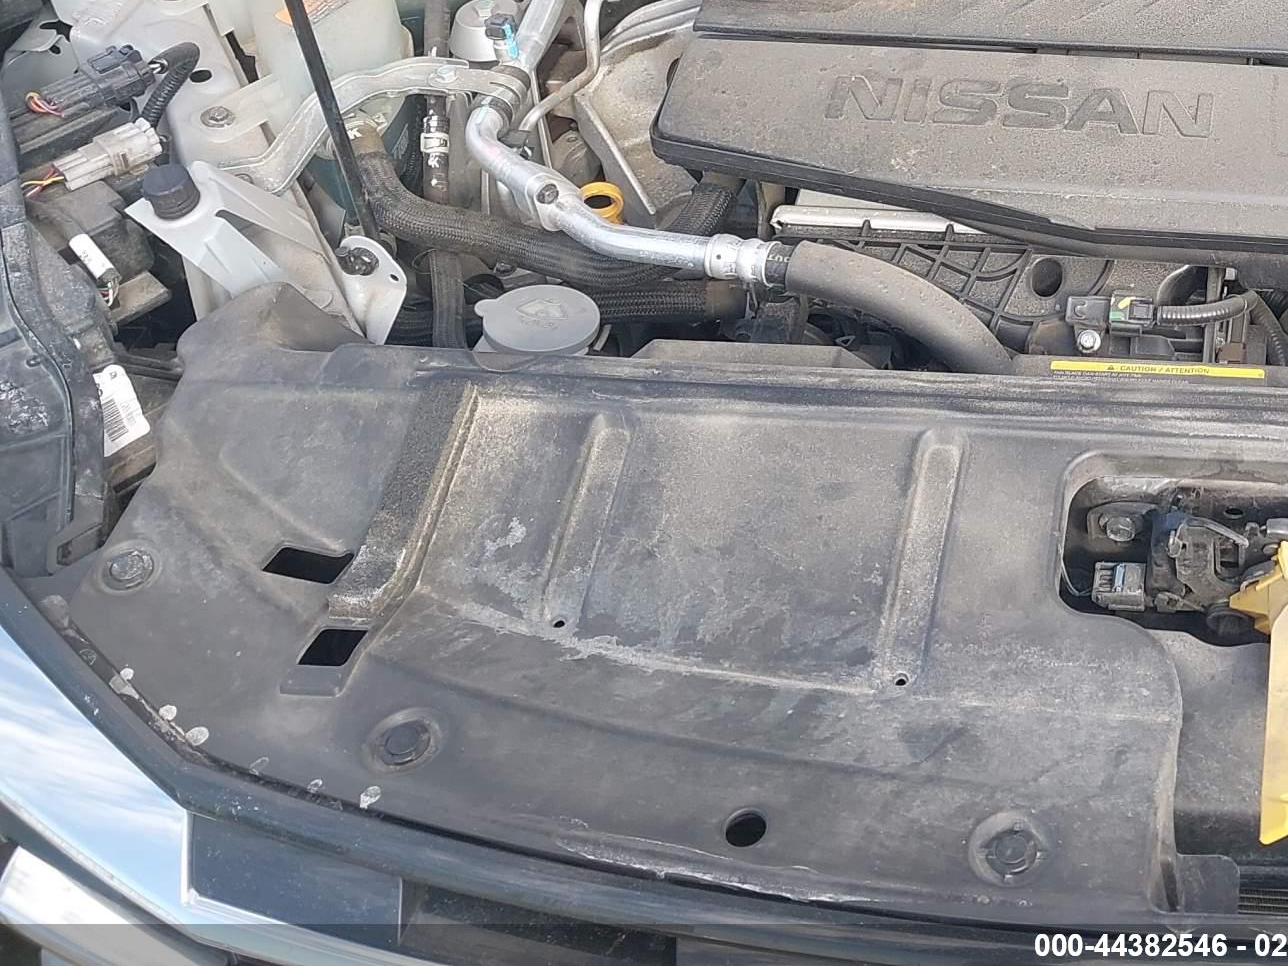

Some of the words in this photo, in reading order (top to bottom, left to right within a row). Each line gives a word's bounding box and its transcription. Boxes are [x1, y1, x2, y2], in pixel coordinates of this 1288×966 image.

[824, 74, 1215, 139] NISSAN
[1119, 365, 1157, 373] CAUTION
[1165, 367, 1211, 375] ATTENTION
